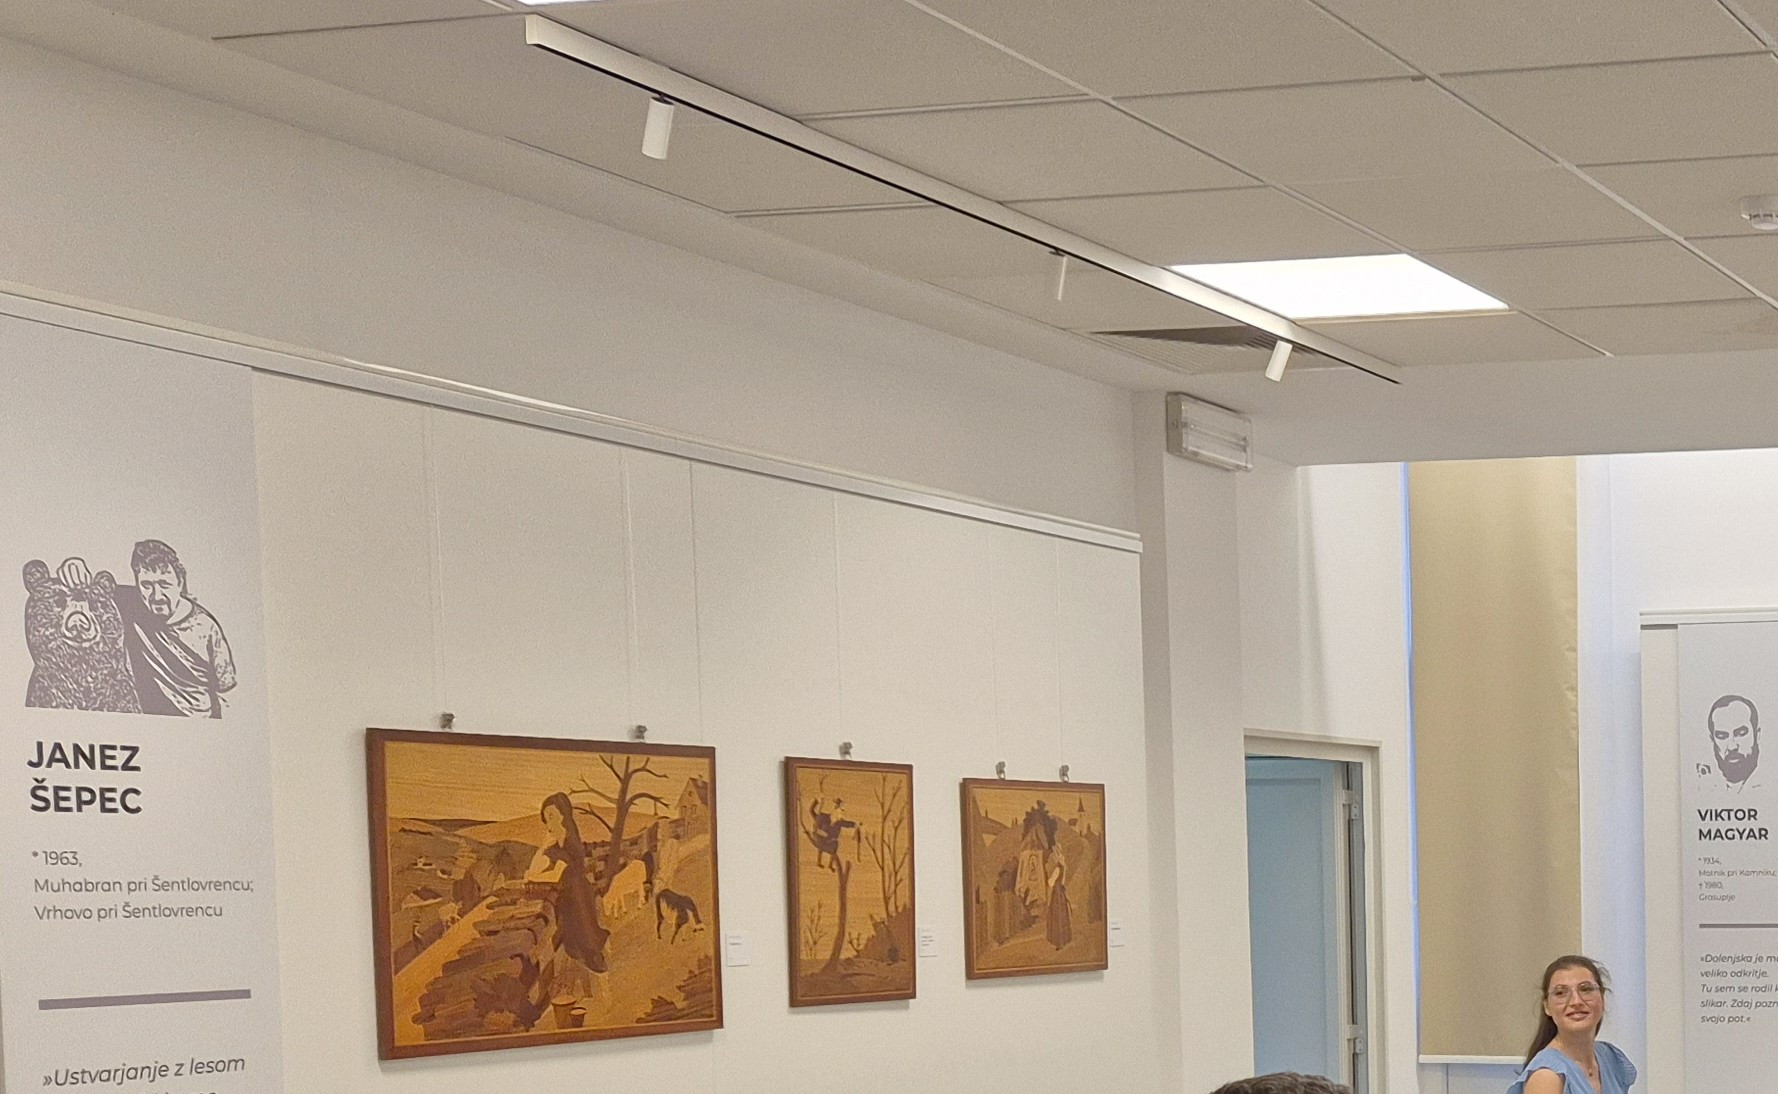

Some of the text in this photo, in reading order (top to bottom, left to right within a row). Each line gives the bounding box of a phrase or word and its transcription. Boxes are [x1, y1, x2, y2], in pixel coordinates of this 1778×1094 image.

[27, 741, 141, 772] JANEZ
[30, 778, 142, 815] ŠEPEC
[1697, 808, 1758, 821] VIKTOR
[1698, 827, 1769, 841] MAGYAR
[43, 851, 83, 867] 1963,
[34, 879, 122, 894] Muhabran
[127, 877, 147, 898] pri
[34, 902, 223, 925] Vrhovo pri Šentlovrencu
[1753, 954, 1763, 964] je
[1700, 969, 1728, 978] veliko
[1701, 984, 1713, 993] Tu
[1714, 985, 1736, 993] sem
[1737, 985, 1749, 993] se
[1751, 984, 1773, 993] rodil
[1700, 999, 1729, 1008] slikar.
[1730, 999, 1753, 1009] Zdaj
[1701, 1015, 1726, 1024] svojo
[42, 1057, 245, 1086] »Ustvarjanje z lesom
